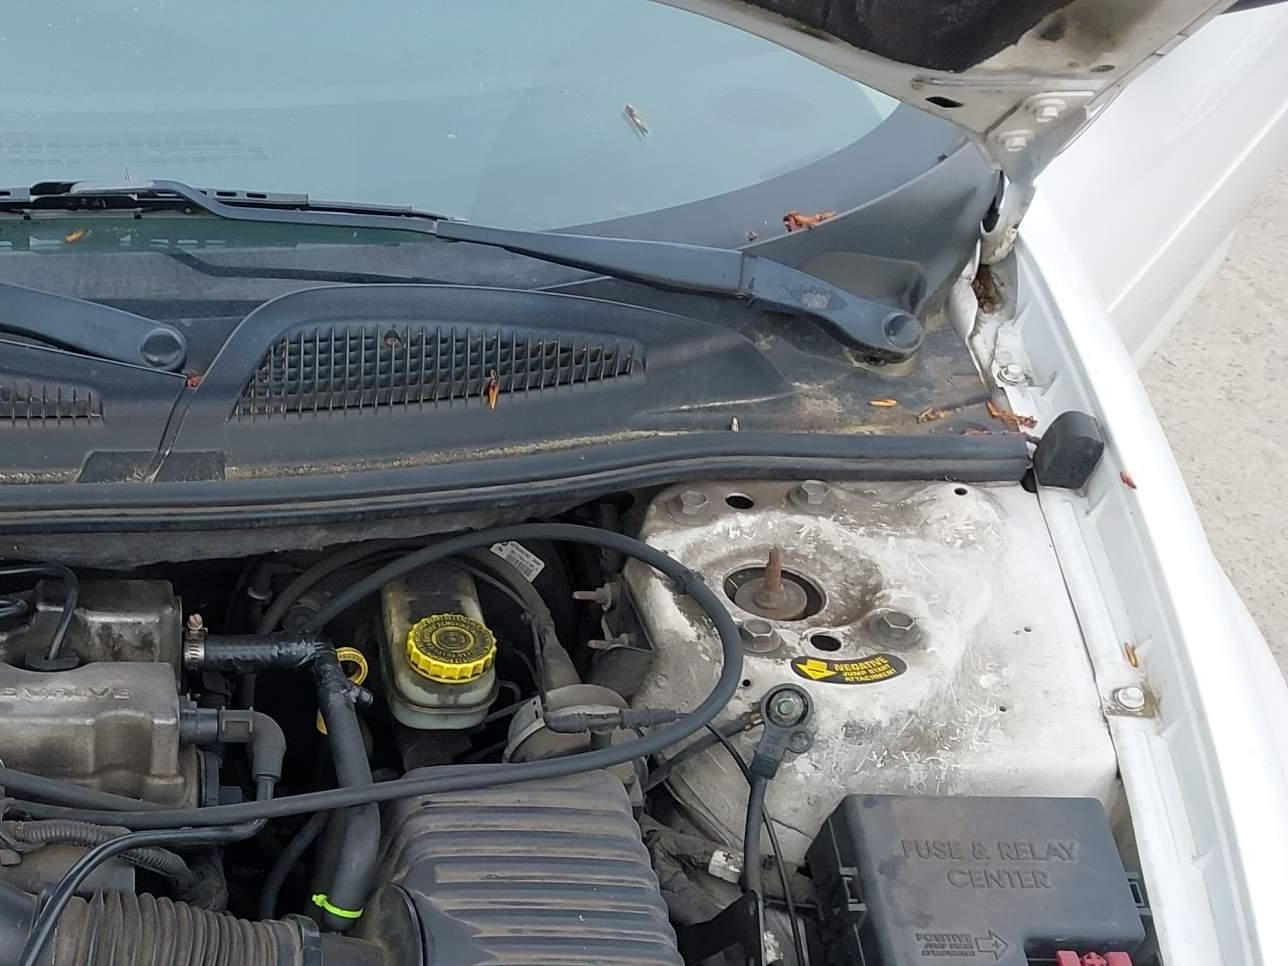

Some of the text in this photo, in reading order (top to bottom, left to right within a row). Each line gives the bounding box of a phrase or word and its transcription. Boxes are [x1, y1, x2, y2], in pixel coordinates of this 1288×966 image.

[834, 656, 888, 671] NEGATIVE
[901, 839, 1079, 862] FUSE & RELAY
[947, 868, 1052, 889] CENTER
